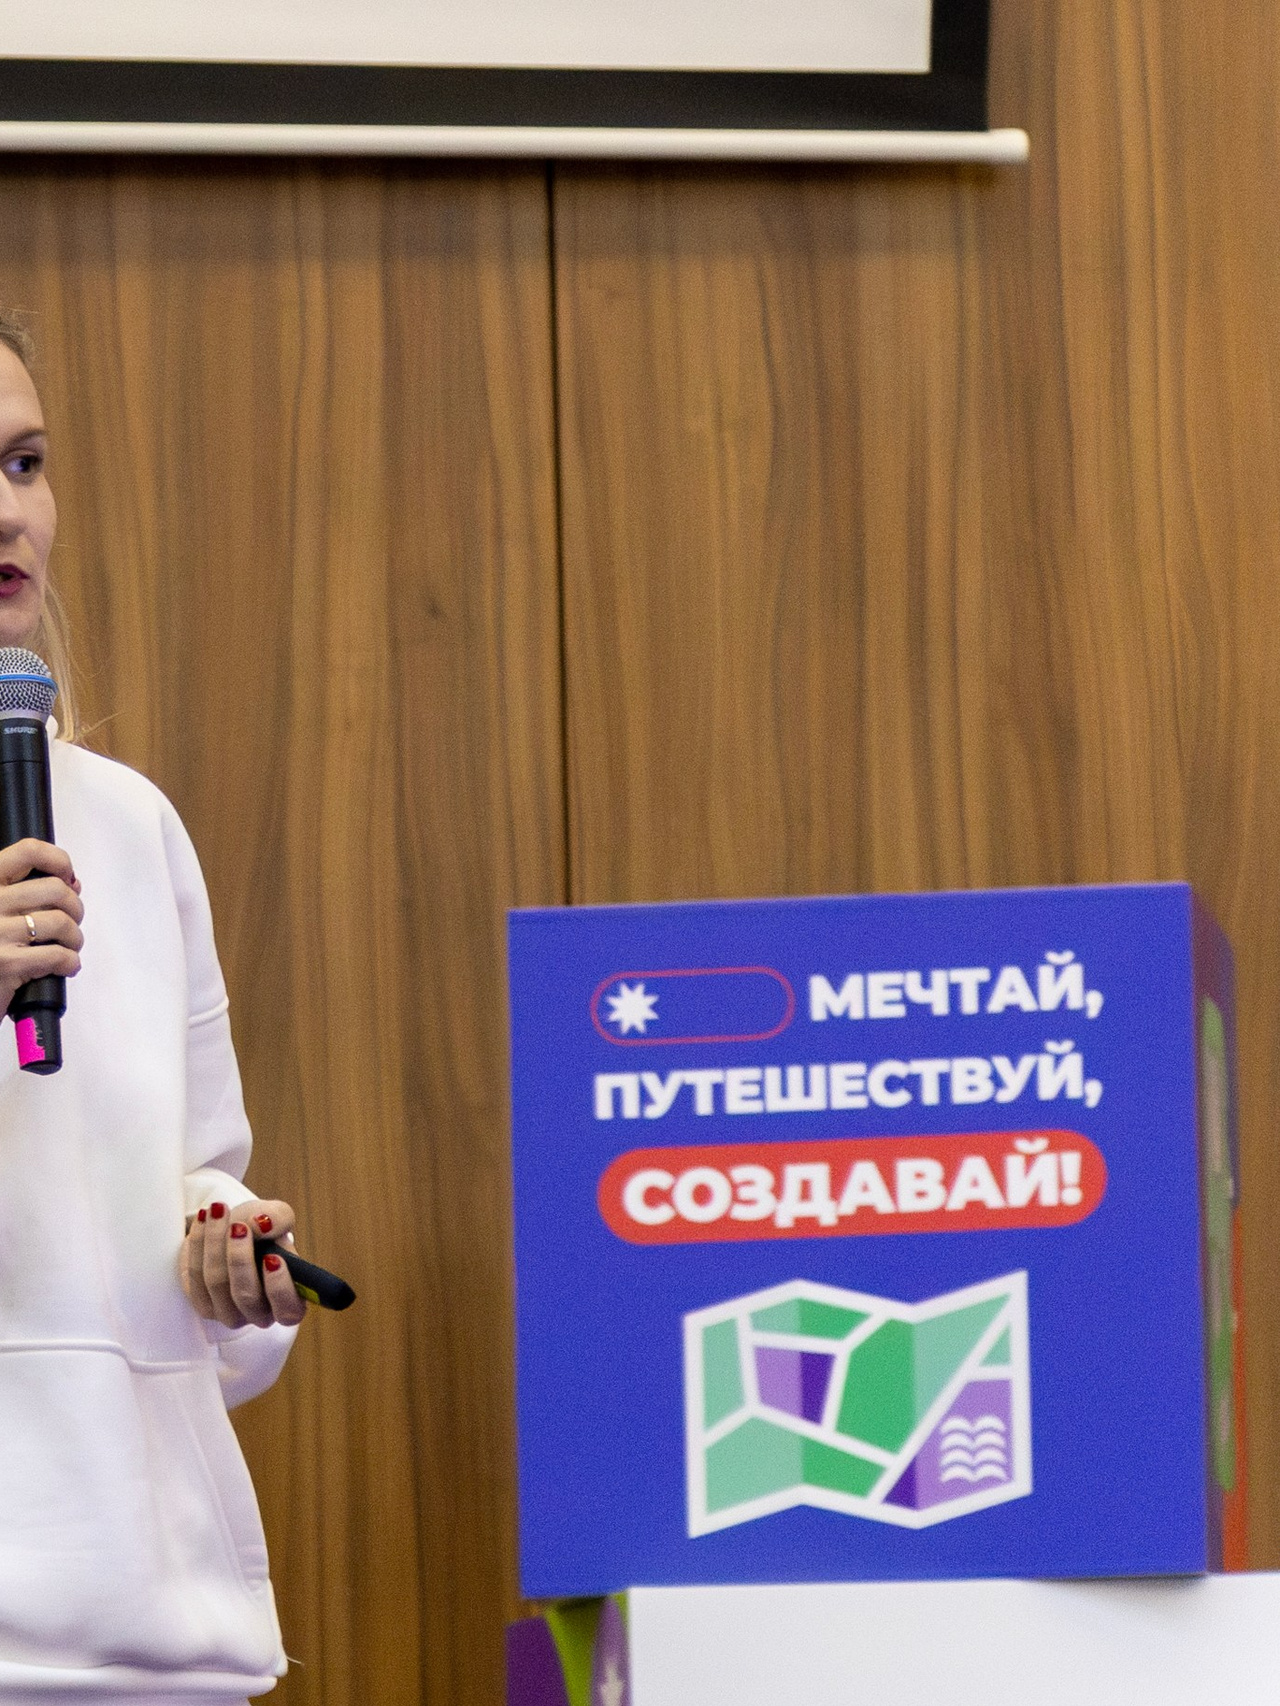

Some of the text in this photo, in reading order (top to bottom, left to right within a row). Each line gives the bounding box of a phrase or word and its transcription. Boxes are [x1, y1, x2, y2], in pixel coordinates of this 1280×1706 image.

[808, 950, 1104, 1022] МЕЧТАЙ,
[593, 1040, 1104, 1121] ПУТЕШЕСТВУЙ,
[622, 1137, 1083, 1229] СОЗДАВАЙ!
